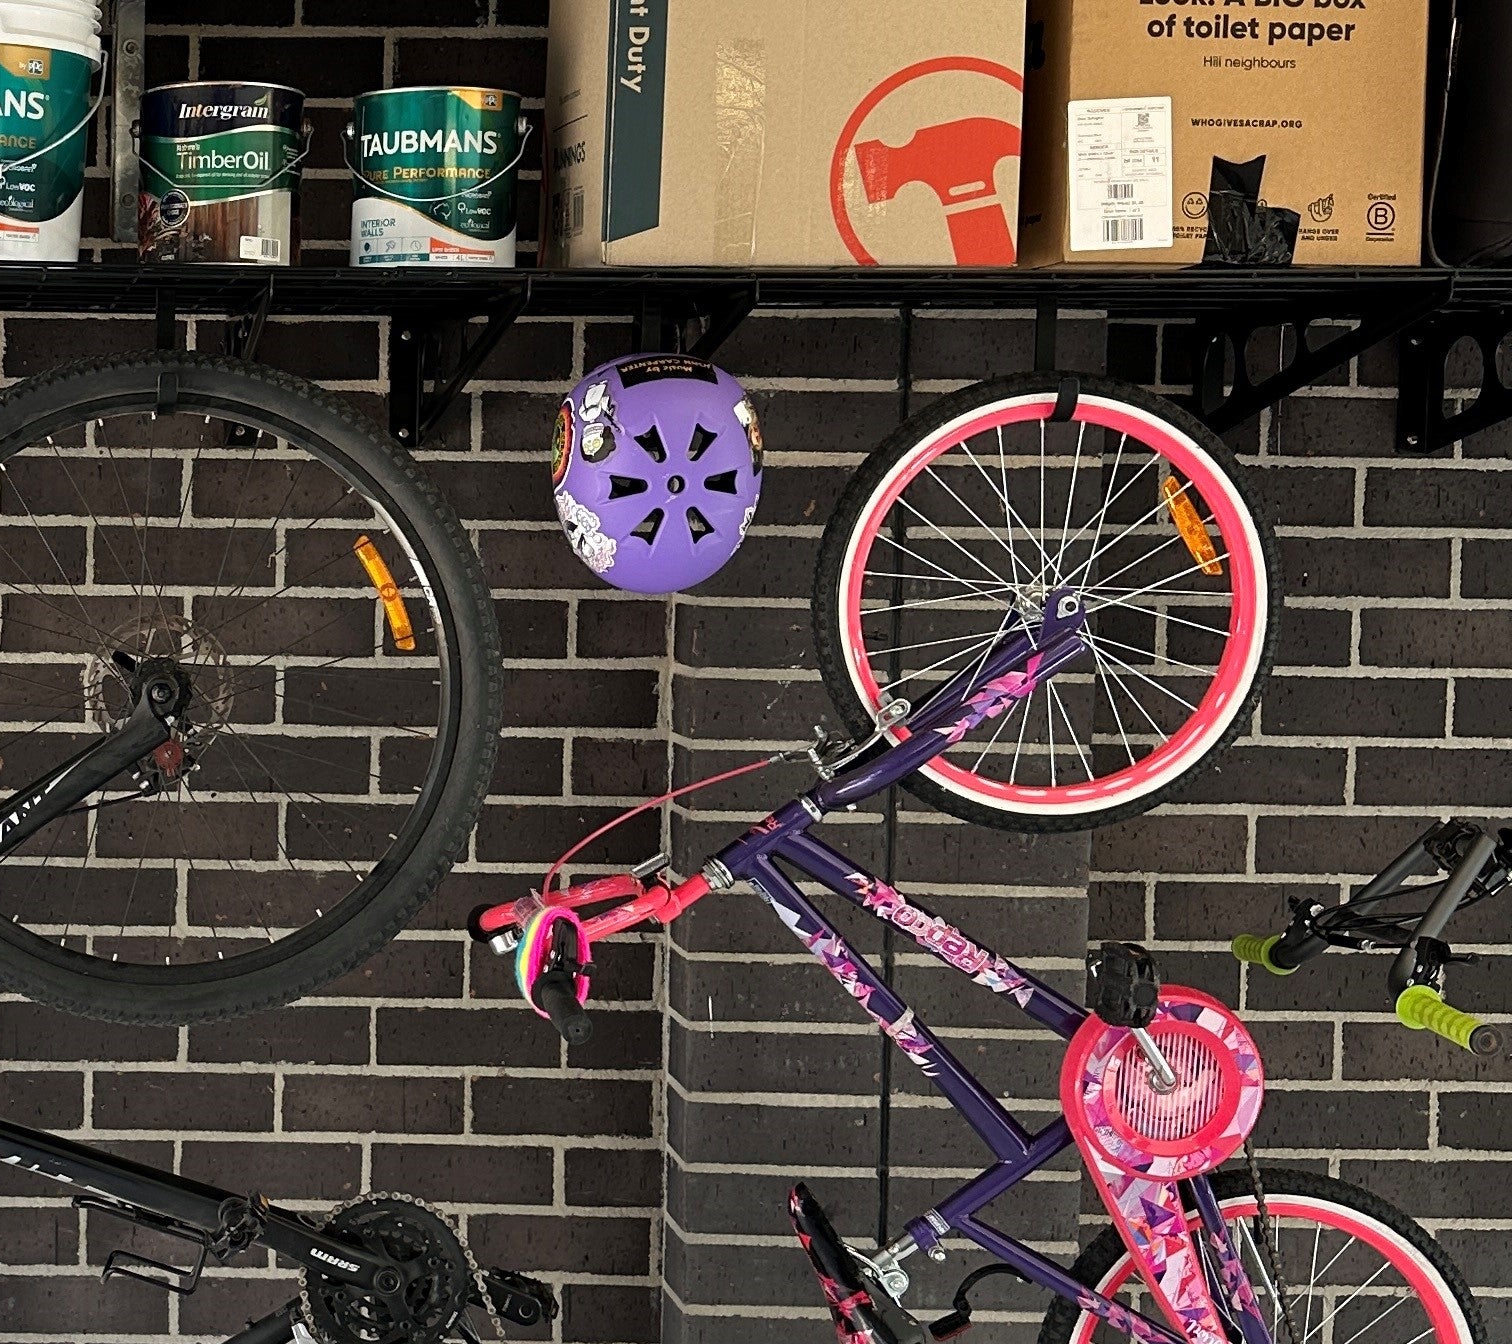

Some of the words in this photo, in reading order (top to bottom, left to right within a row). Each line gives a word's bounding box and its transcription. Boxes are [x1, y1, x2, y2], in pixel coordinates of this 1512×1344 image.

[1147, 13, 1177, 38] of
[1183, 14, 1259, 39] toilet
[1268, 21, 1356, 47] paper
[620, 26, 650, 94] Duty
[1225, 57, 1297, 71] neighbours
[178, 103, 269, 121] Intergrain
[1190, 118, 1303, 128] WHOGIVESACRAP.ORG
[360, 129, 498, 158] TAUBMANS
[176, 149, 269, 171] TimberOil
[360, 218, 396, 228] INTERIOR
[1374, 208, 1388, 225] B
[891, 903, 990, 974] Repco
[309, 1248, 361, 1274] SRAM
